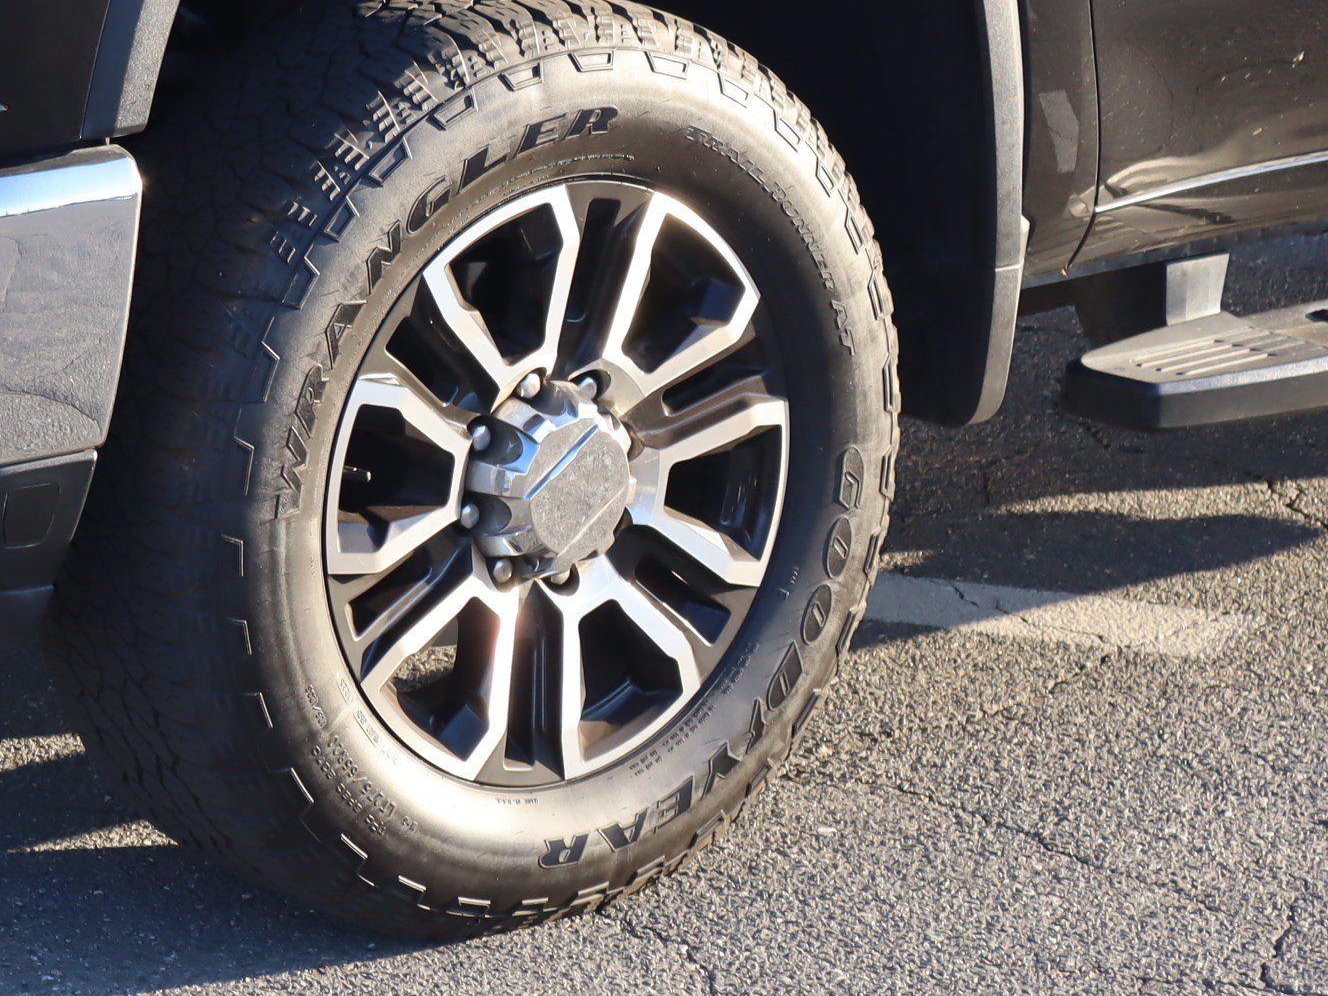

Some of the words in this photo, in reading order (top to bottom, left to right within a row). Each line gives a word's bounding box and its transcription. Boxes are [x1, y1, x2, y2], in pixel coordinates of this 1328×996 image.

[273, 104, 620, 516] WRANGLER
[829, 299, 857, 357] AT
[537, 445, 865, 870] GOODYEAR
